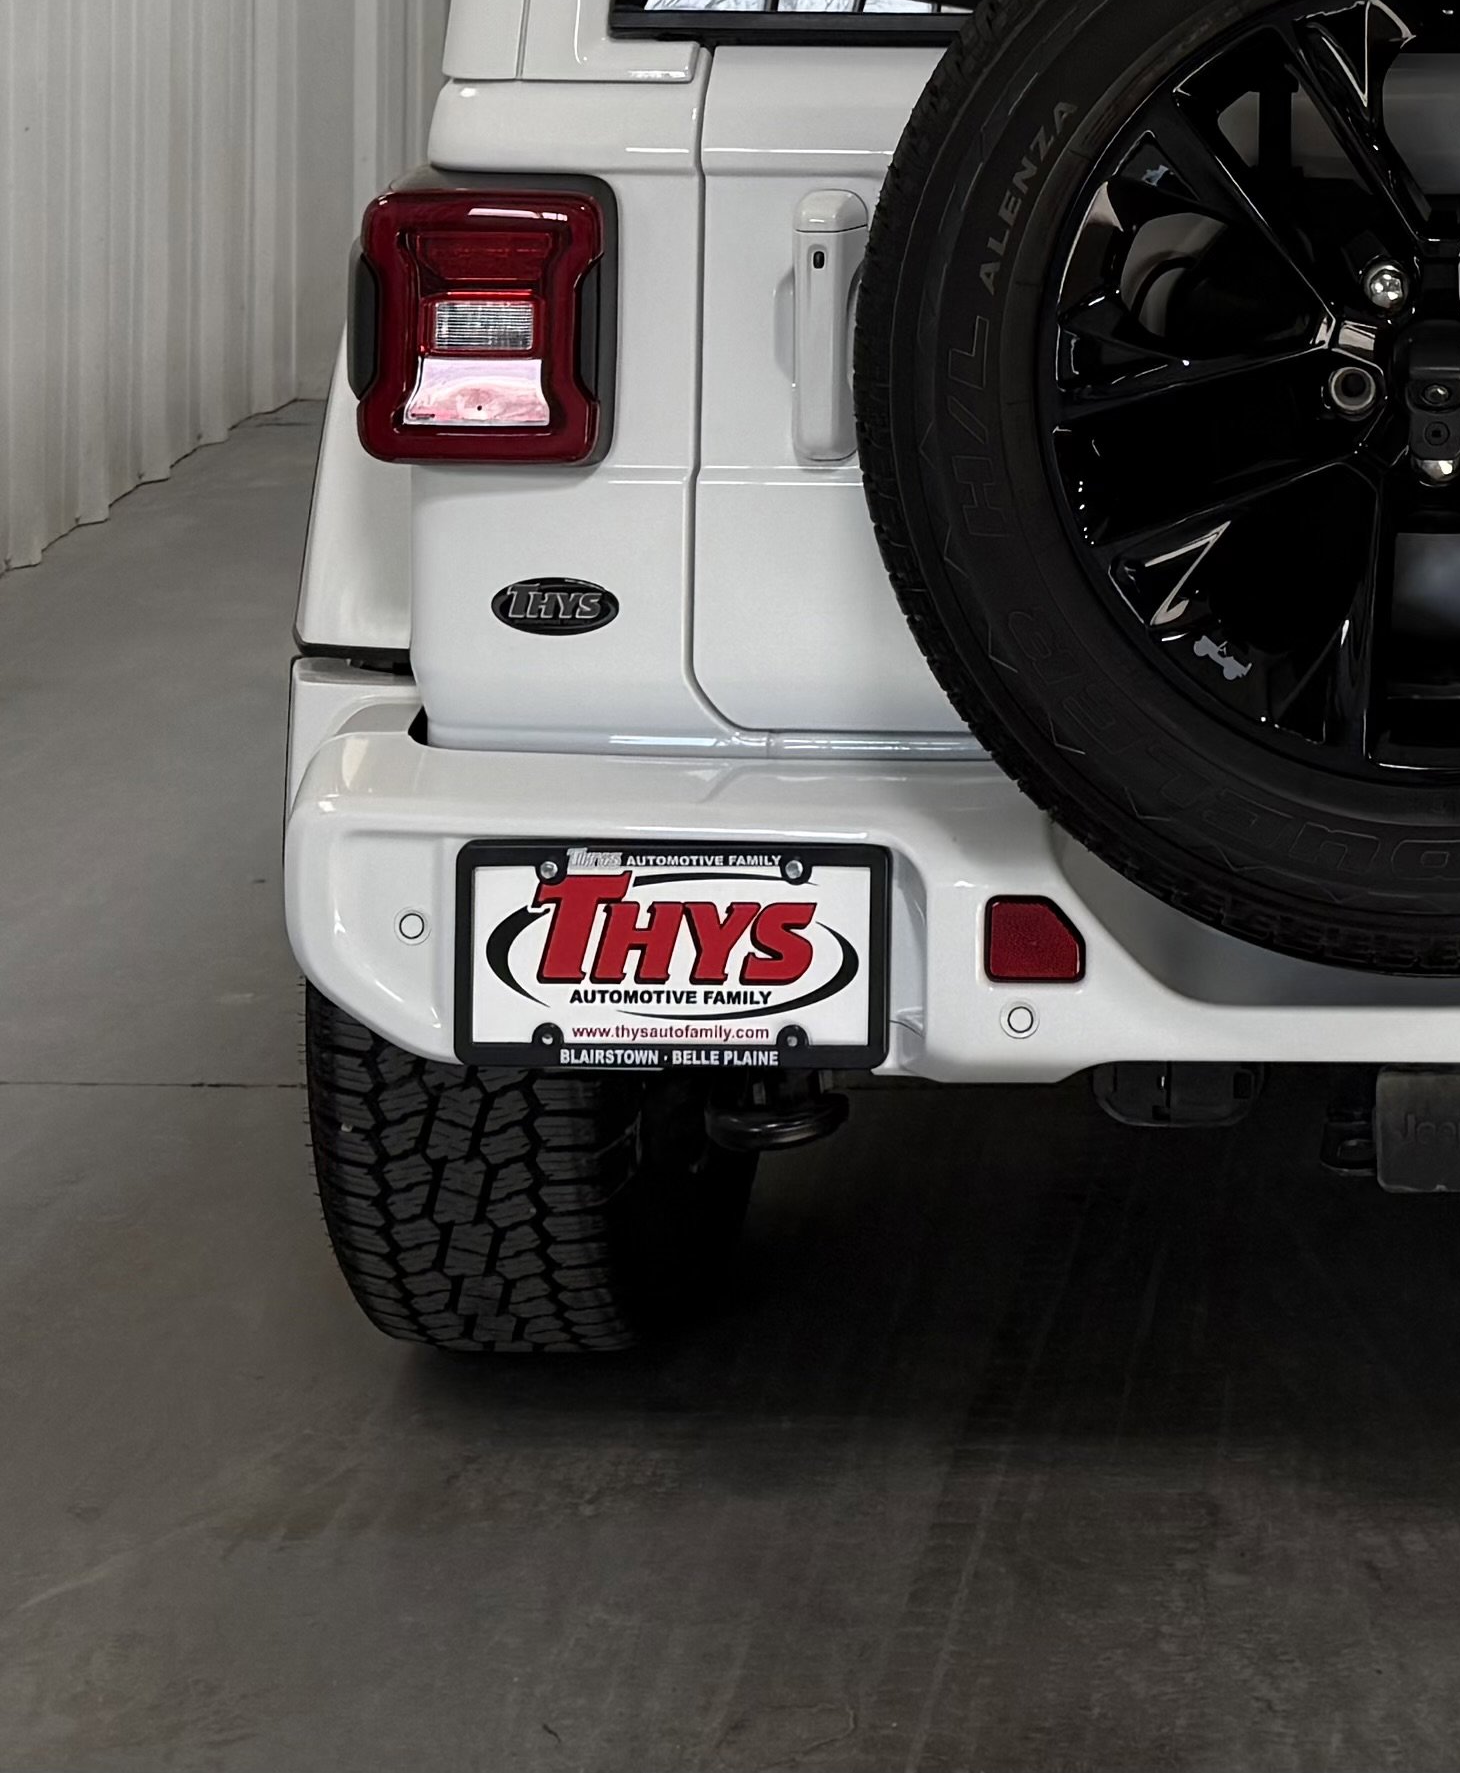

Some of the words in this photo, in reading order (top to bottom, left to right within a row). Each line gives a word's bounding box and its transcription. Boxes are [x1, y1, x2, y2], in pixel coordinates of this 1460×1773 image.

[977, 100, 1079, 296] ALENZA
[507, 583, 602, 619] THYS
[626, 855, 724, 866] AUTOMOTIVE
[728, 855, 782, 866] FAMILY
[533, 871, 817, 986] THYS
[569, 990, 698, 1004] AUTOMOTIVE
[703, 991, 772, 1005] FAMILY
[572, 1024, 770, 1042] www.thysautofamily.com
[560, 1048, 659, 1065] BLAIRSTOWN
[672, 1050, 720, 1065] BELLE
[723, 1051, 779, 1066] PLAINE
